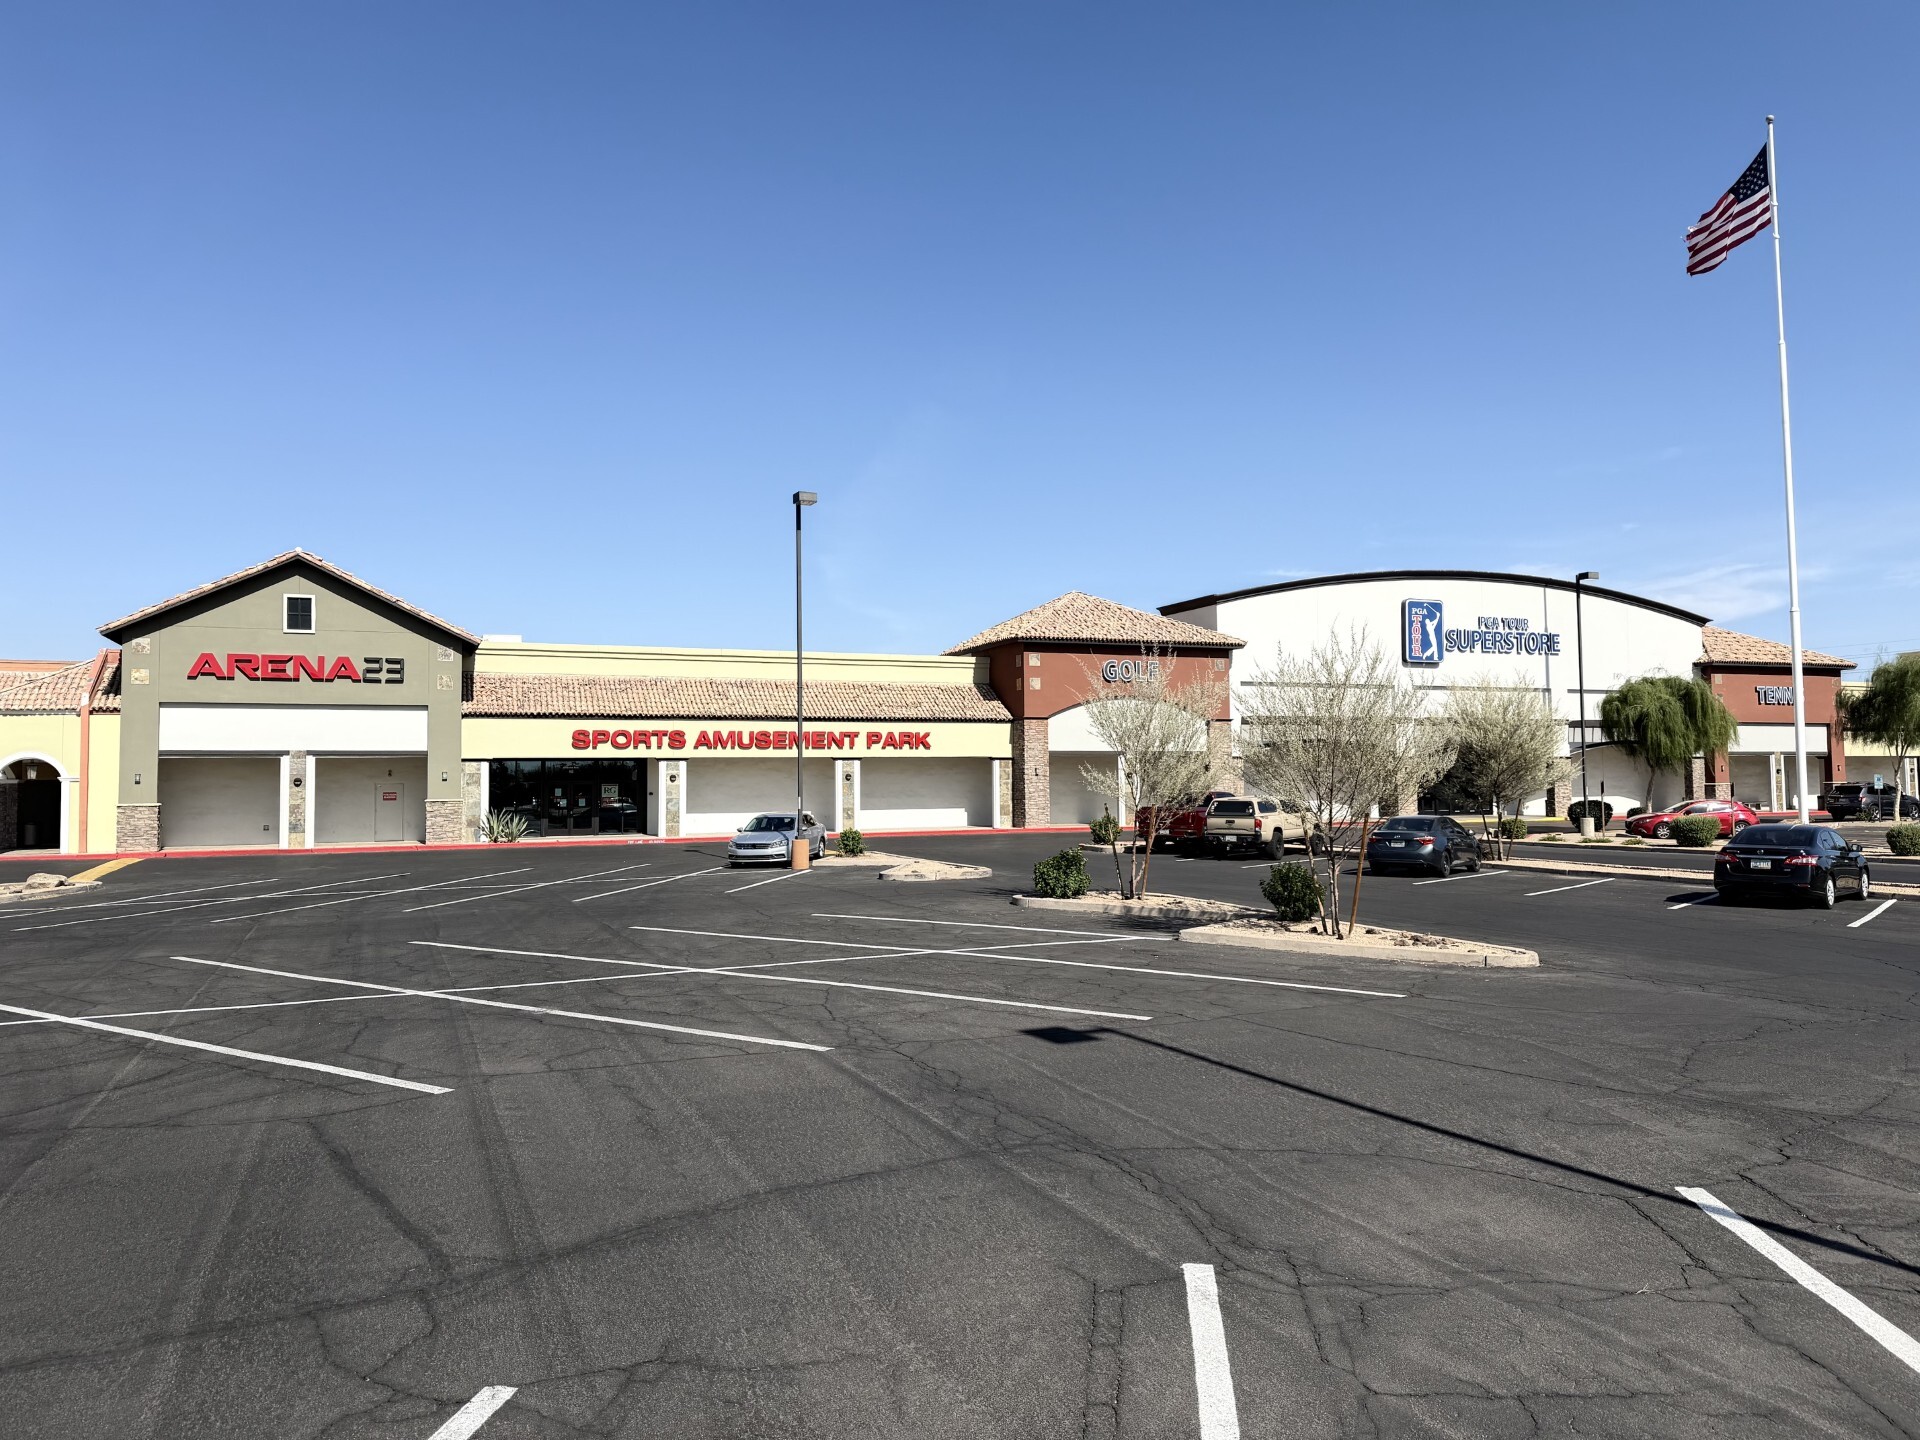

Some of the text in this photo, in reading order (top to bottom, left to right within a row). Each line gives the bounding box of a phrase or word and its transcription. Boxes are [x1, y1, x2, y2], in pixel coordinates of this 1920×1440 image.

[1411, 607, 1428, 615] PGA
[1478, 616, 1530, 631] PGA TOUR
[1411, 614, 1423, 657] TOUR
[1445, 629, 1560, 655] SUPERSTORE
[1102, 659, 1159, 682] GOLF
[1755, 685, 1796, 706] TENN
[571, 729, 932, 750] SPORTS AMUSEMENT PARK
